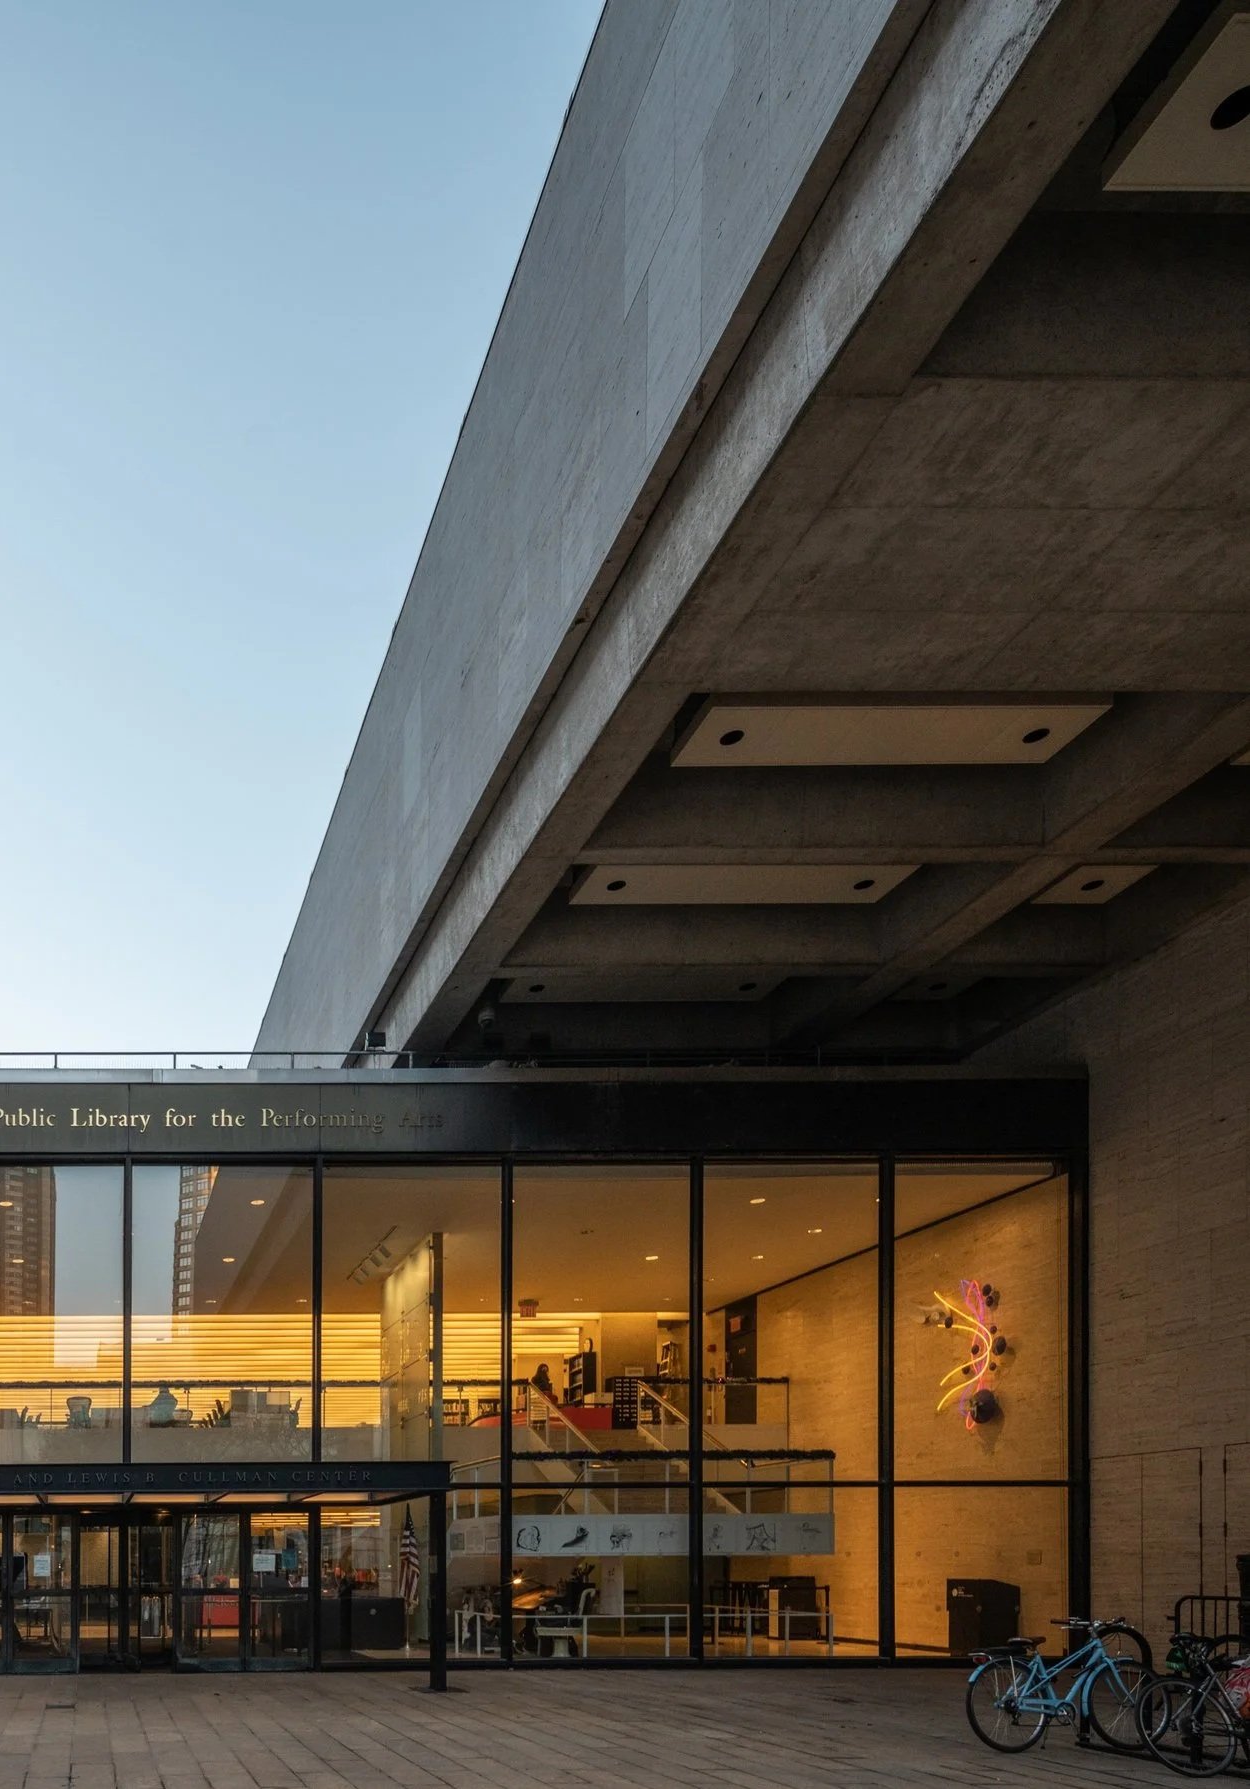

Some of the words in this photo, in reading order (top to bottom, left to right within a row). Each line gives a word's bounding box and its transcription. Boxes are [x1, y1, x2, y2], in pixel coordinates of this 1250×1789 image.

[70, 1107, 151, 1133] Library
[165, 1108, 197, 1127] for
[211, 1108, 246, 1127] the
[260, 1107, 385, 1133] Performing
[398, 1108, 446, 1128] Arts
[13, 1472, 54, 1485] AND
[67, 1471, 132, 1484] LEWIS
[178, 1471, 278, 1483] CULLMAN
[291, 1470, 373, 1482] CENTER
